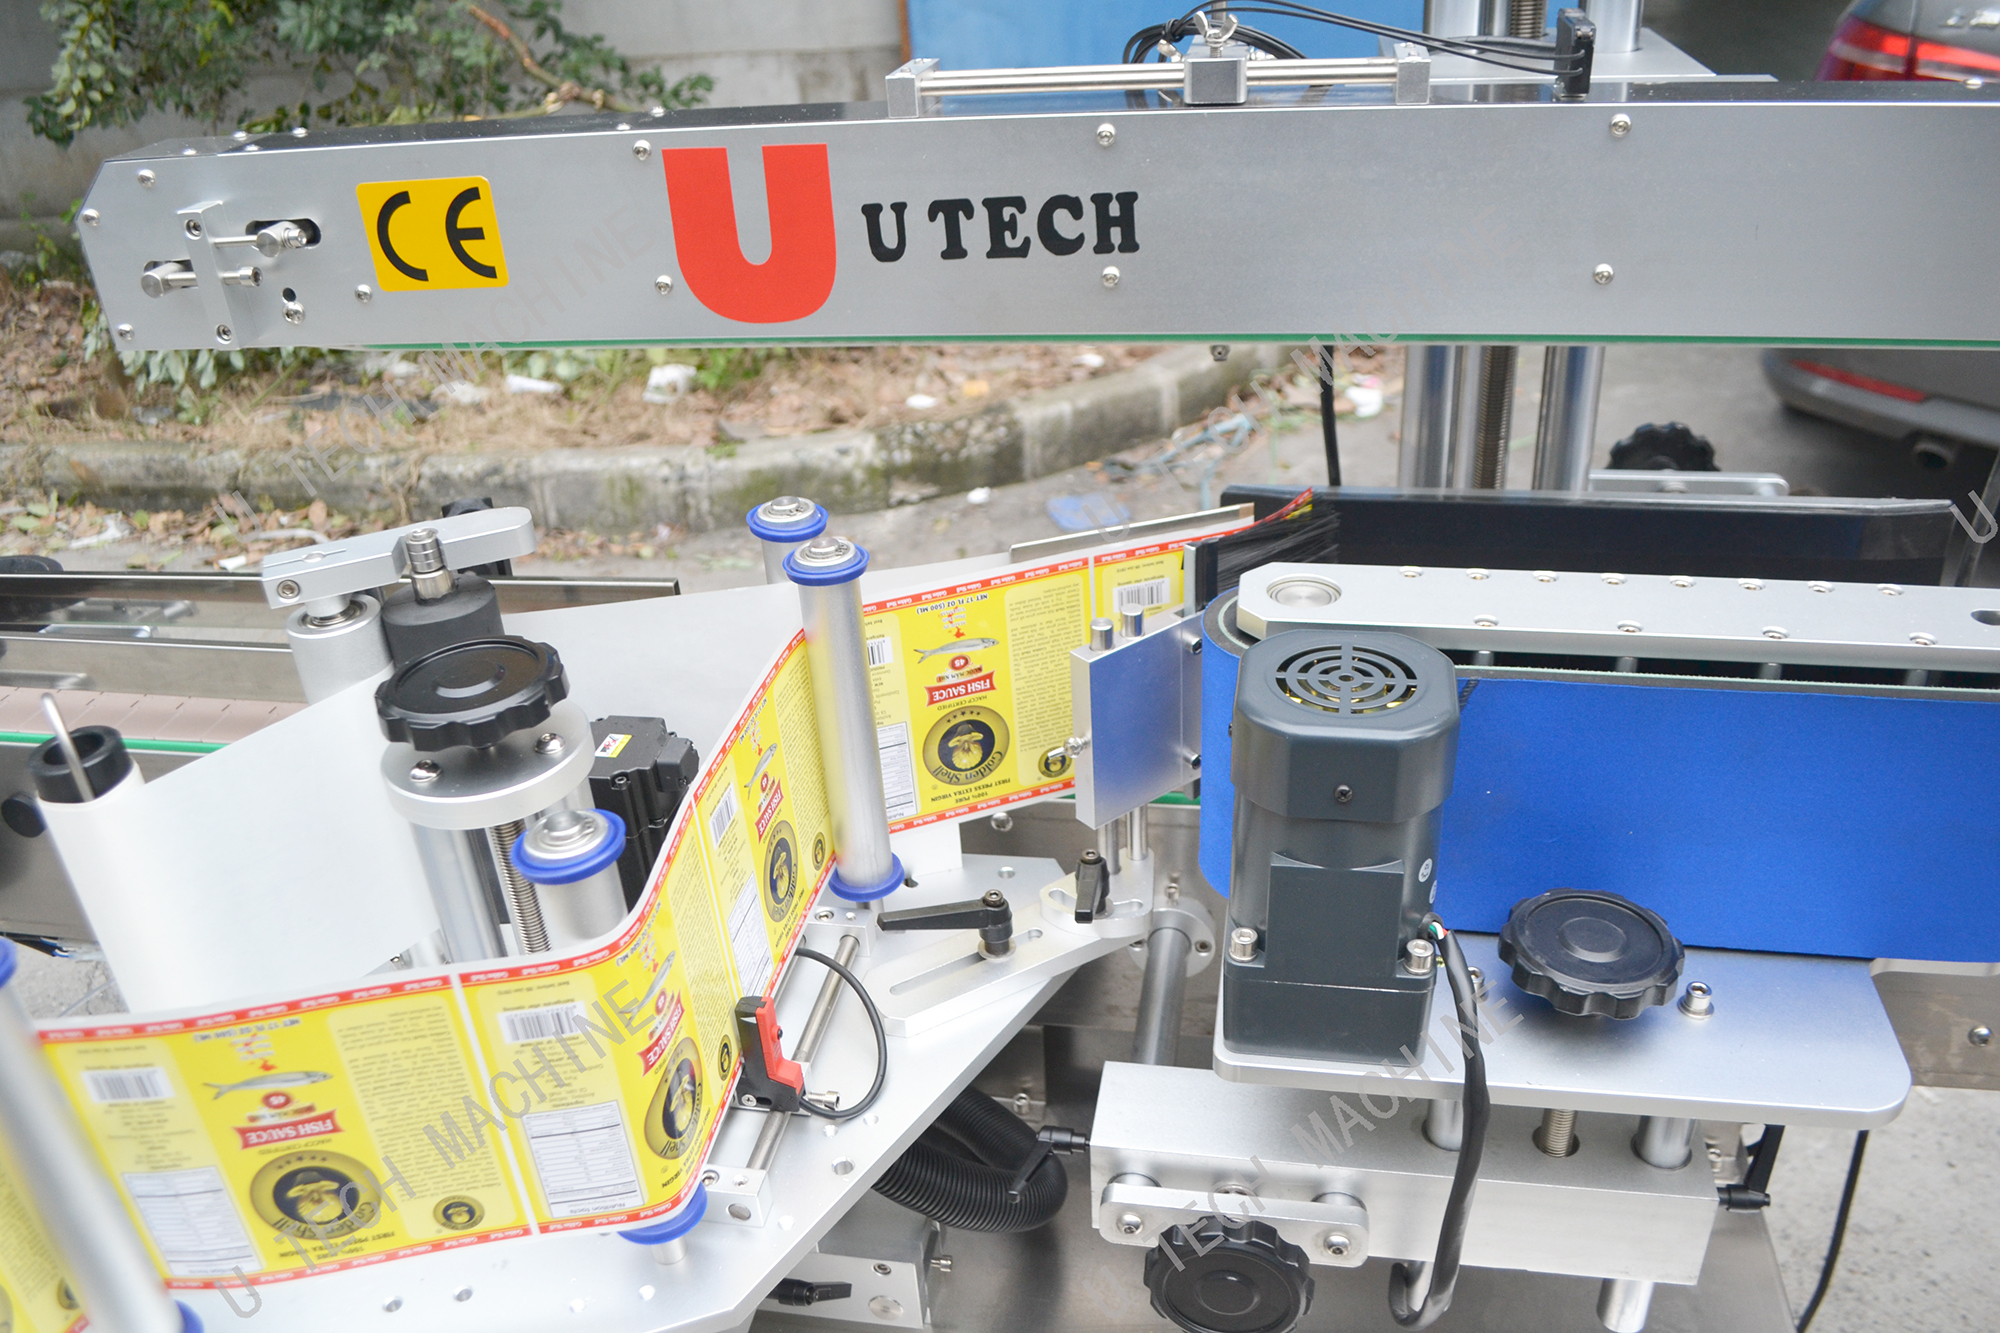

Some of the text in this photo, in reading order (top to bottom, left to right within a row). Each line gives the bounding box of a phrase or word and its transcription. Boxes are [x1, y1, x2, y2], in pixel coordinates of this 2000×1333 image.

[662, 143, 837, 324] U
[861, 190, 1140, 263] U TECH
[975, 593, 988, 601] NET
[916, 606, 928, 615] ML)
[930, 602, 946, 611] (500
[932, 679, 990, 700] FISH SAUCE
[937, 695, 987, 711] HACCP CERTIFIED
[932, 750, 1003, 783] Golden Shell
[974, 782, 992, 790] PRESS
[994, 778, 1010, 786] FIRST
[931, 793, 952, 802] VIRGIN
[647, 1028, 671, 1066] SAUCE
[246, 1119, 334, 1144] FISH SAUCE
[662, 1168, 682, 1188] VIRGIN
[591, 1203, 625, 1212] Nutrition
